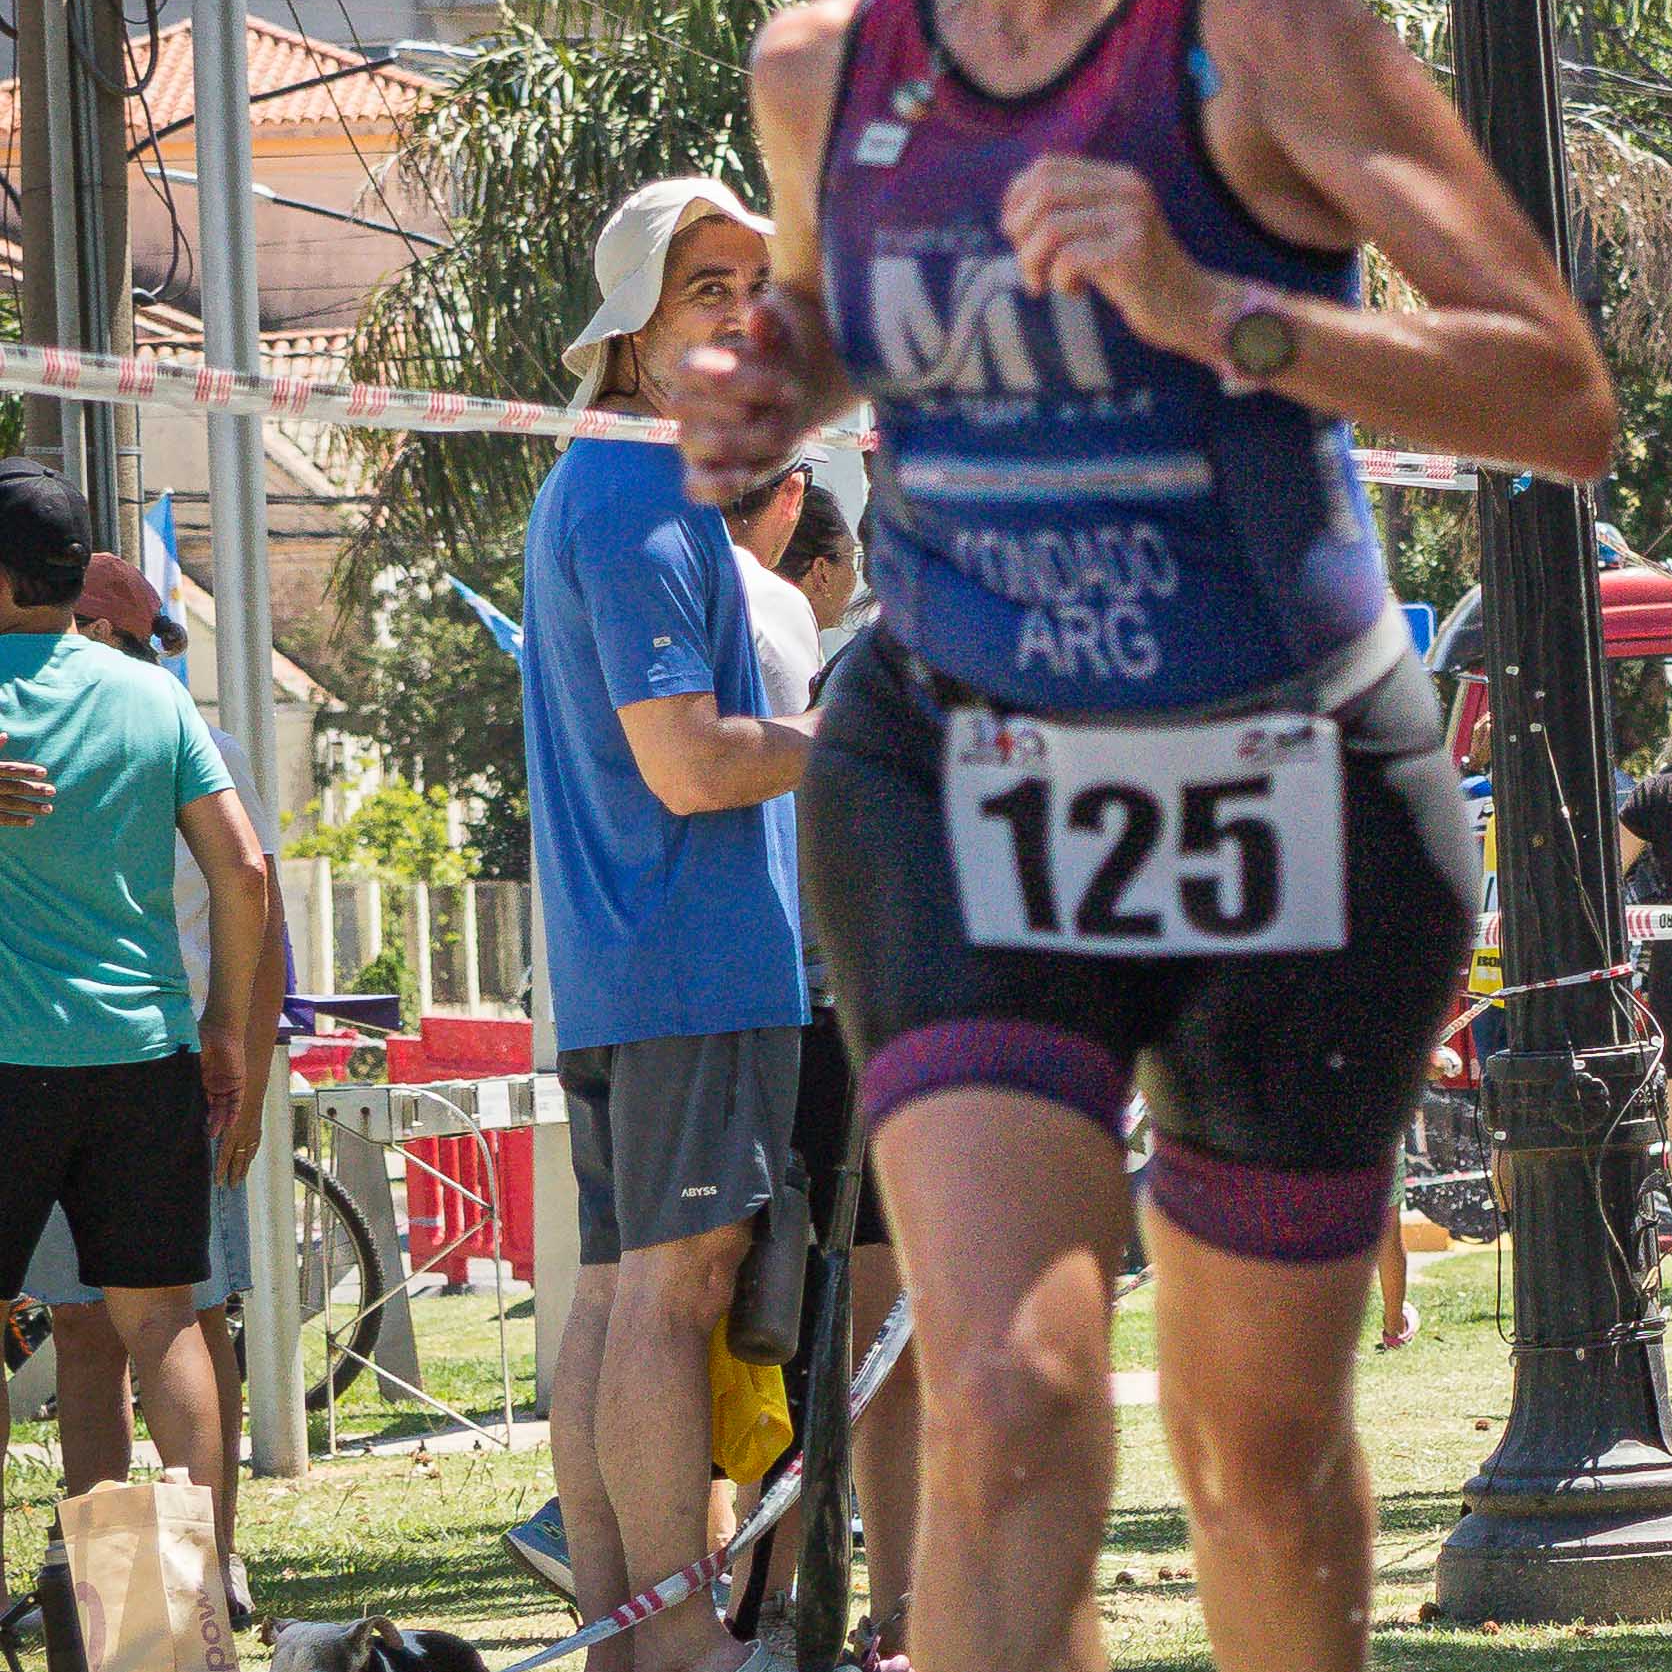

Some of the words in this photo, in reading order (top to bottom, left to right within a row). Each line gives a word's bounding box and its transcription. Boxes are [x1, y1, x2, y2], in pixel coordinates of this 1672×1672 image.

[1016, 604, 1162, 679] ARG
[979, 773, 1284, 937] 125
[681, 1186, 718, 1198] ABYSS
